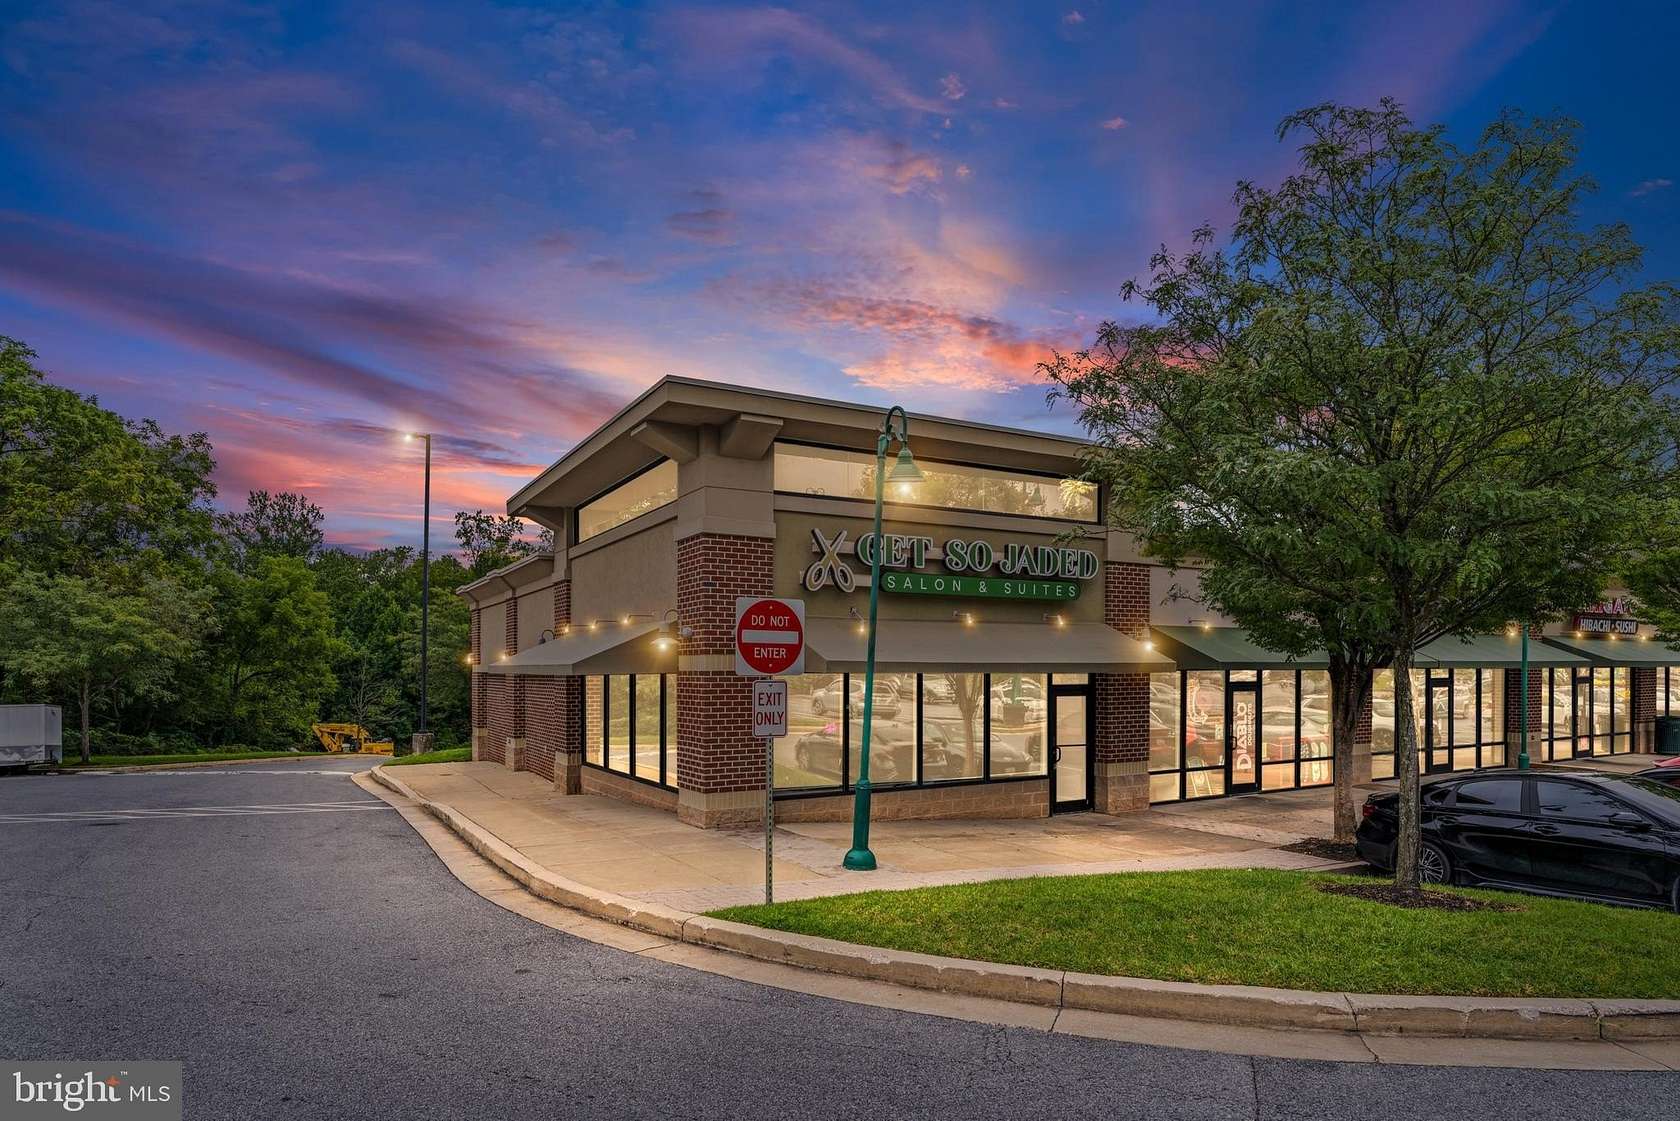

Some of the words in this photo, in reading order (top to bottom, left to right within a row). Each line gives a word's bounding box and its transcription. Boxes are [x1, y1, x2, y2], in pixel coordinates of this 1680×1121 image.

[856, 532, 933, 568] GET
[944, 538, 994, 572] SO
[1000, 543, 1099, 580] JADED
[886, 575, 962, 592] SALON
[978, 581, 988, 593] &
[1004, 582, 1077, 598] SUITES
[751, 614, 766, 626] DO
[770, 615, 790, 627] NOT
[1580, 618, 1611, 633] HIBACHI
[1614, 620, 1637, 634] SUSHI
[754, 647, 787, 659] ENTER
[758, 692, 783, 707] EXIT
[755, 711, 785, 726] ONLY
[1236, 702, 1252, 770] DIABLO
